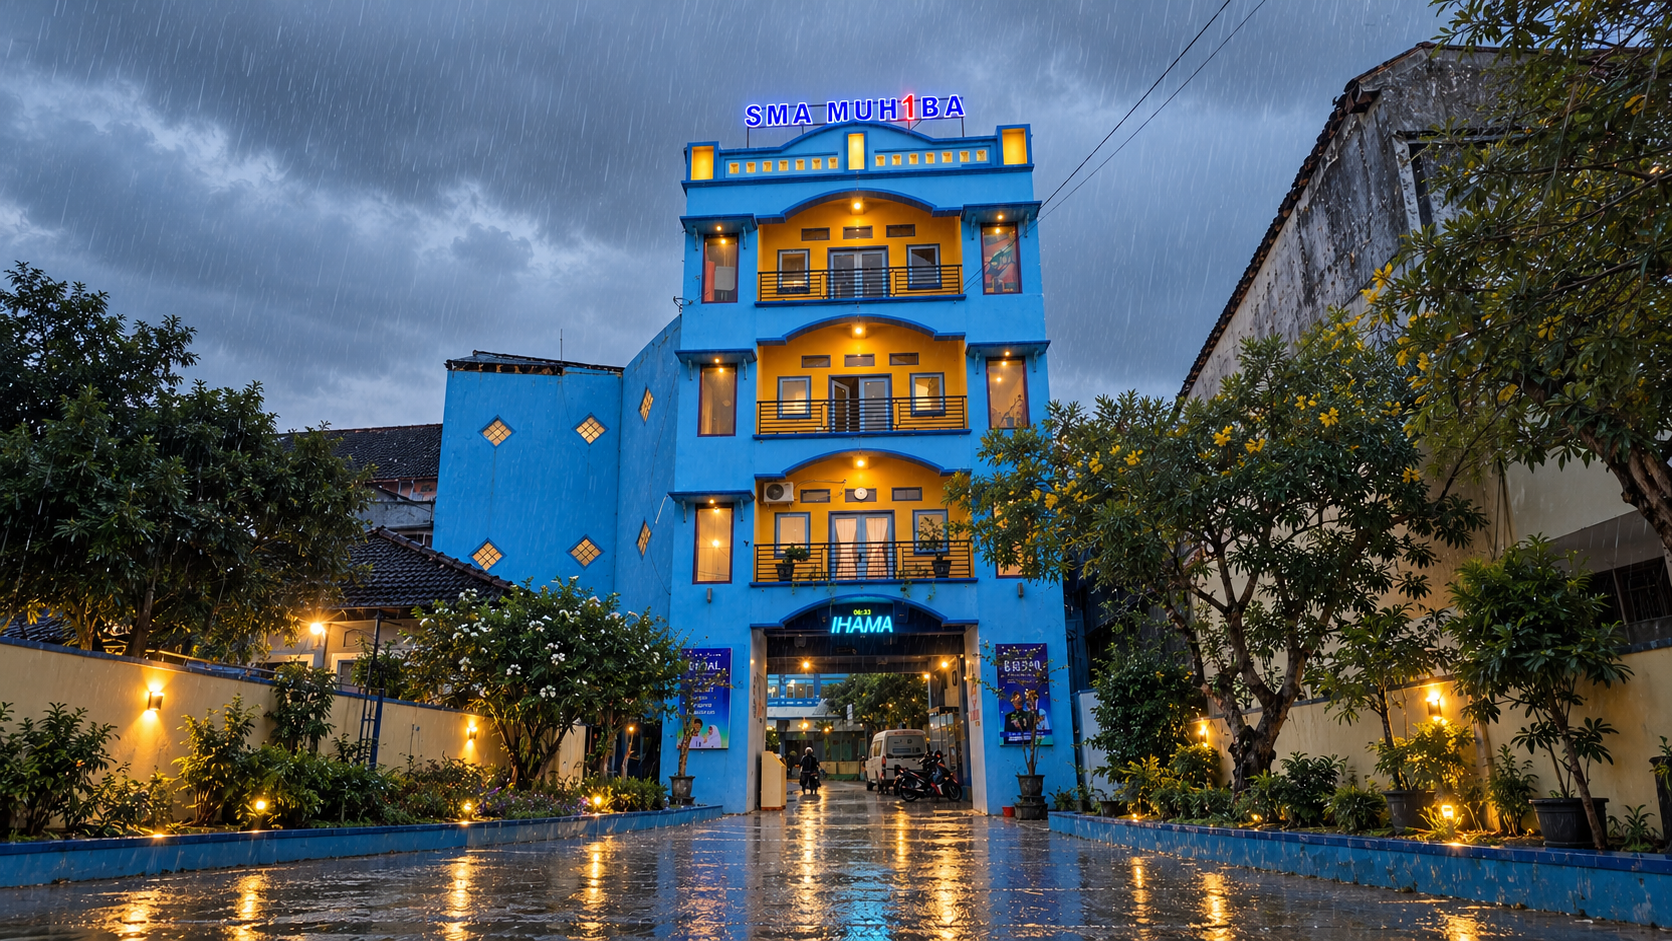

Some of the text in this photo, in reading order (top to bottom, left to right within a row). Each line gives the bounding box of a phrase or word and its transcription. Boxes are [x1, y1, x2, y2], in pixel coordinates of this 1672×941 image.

[745, 94, 965, 127] SMA MUH1BA
[831, 616, 893, 633] IHAMA
